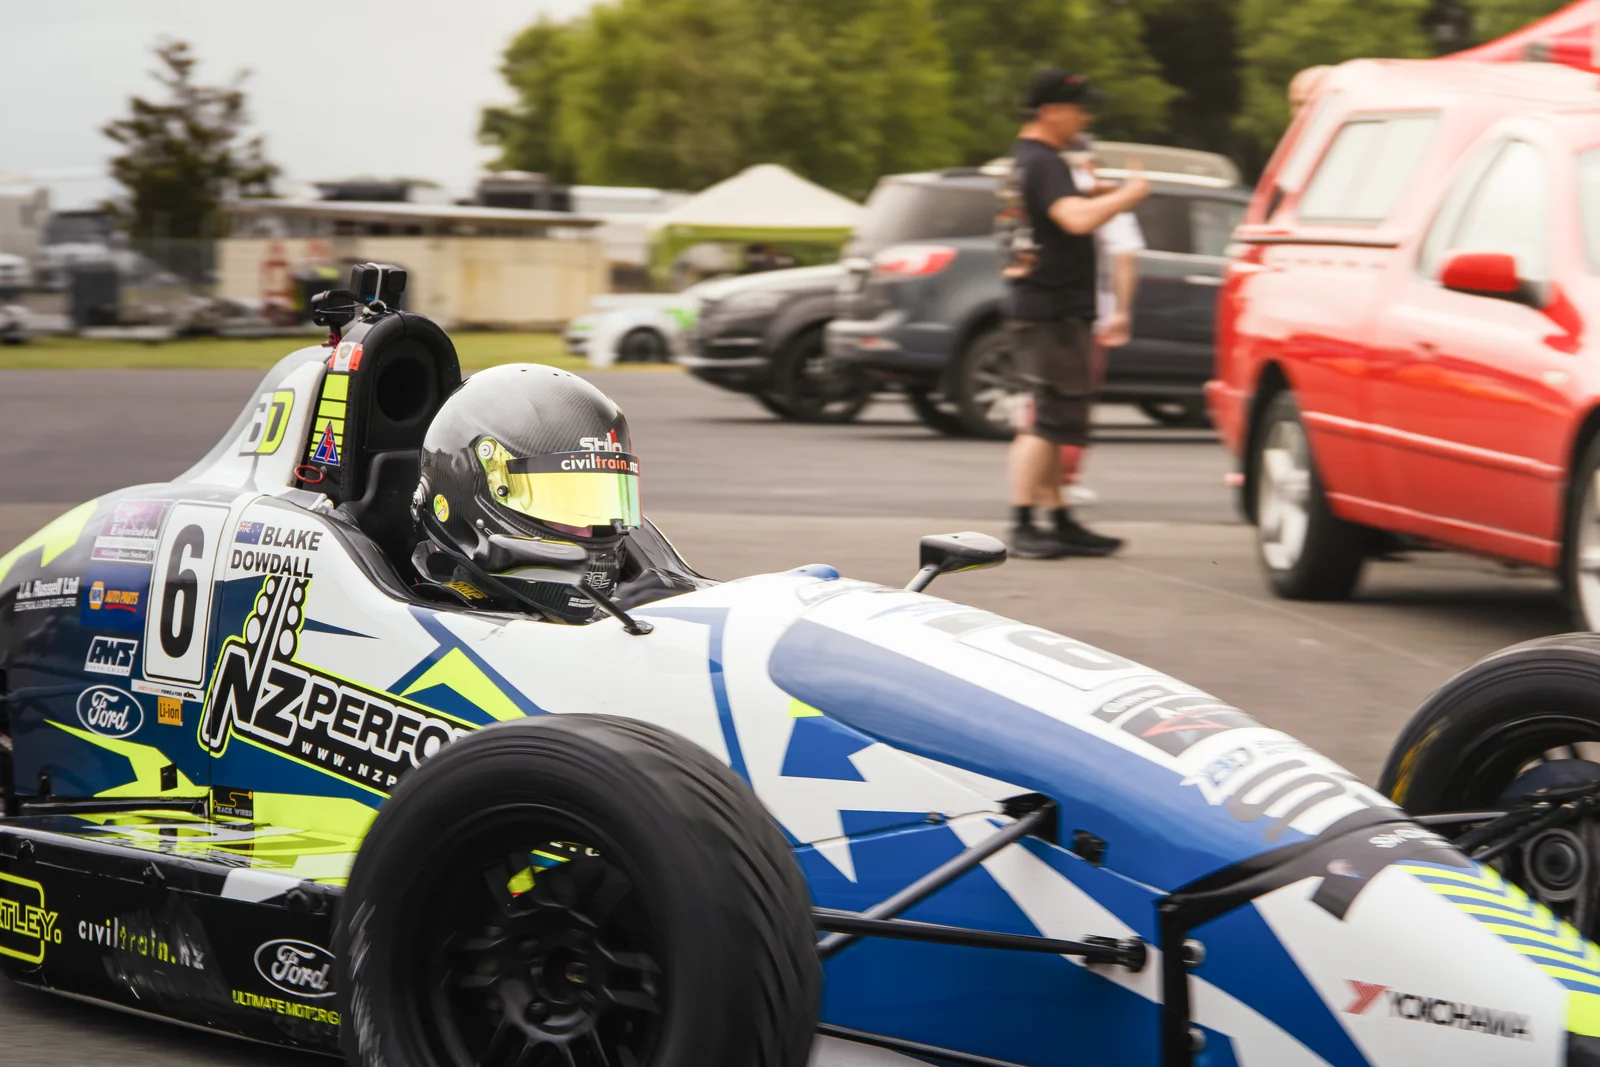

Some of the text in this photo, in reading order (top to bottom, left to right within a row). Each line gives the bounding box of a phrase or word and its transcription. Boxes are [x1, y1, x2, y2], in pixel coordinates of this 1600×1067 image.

[560, 453, 639, 473] civiltrain.nz
[261, 526, 323, 551] BLAKE
[230, 549, 313, 579] DOWDALL
[62, 576, 80, 595] Ltd
[159, 523, 205, 658] 6
[87, 691, 130, 731] Ford
[159, 703, 180, 720] Li-ion
[78, 917, 205, 970] civiltrain.nz
[270, 945, 331, 990] Ford
[232, 989, 286, 1014] ULTIMATE
